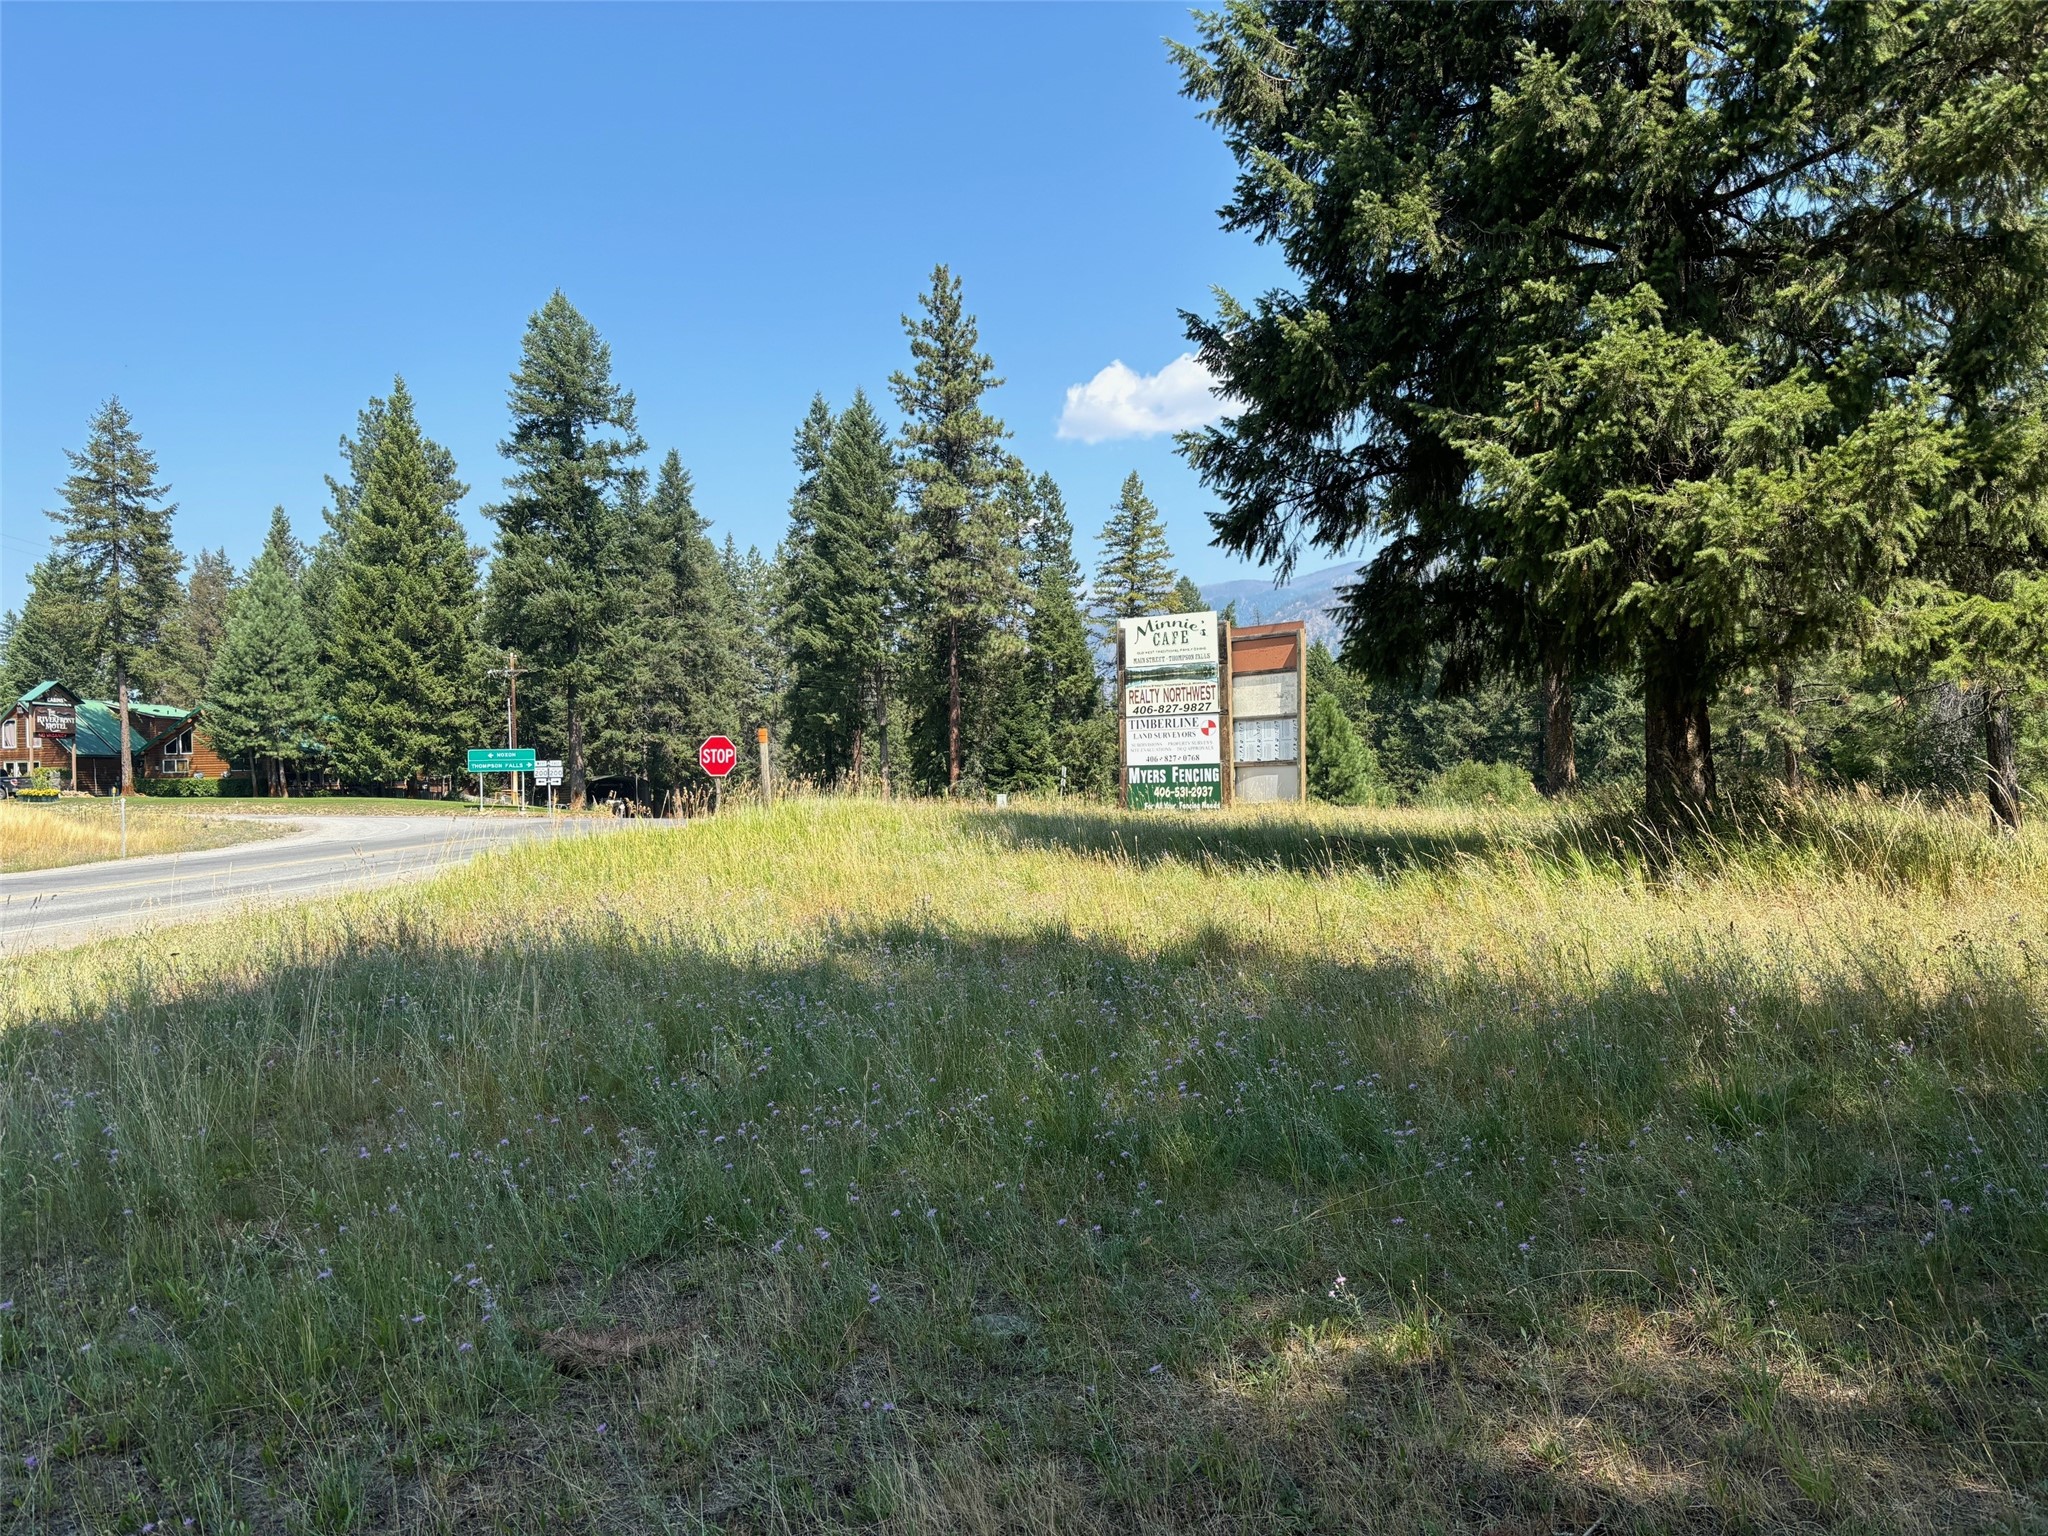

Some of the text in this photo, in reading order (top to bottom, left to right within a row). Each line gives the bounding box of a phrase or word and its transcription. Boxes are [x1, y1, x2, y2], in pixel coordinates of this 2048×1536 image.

[1134, 618, 1206, 644] Minnie's
[1153, 630, 1188, 646] CAFE
[1129, 685, 1216, 704] REALTY NORTHWEST
[1133, 702, 1212, 714] 406-827-9827
[1129, 717, 1199, 729] TIMBERLINE
[703, 749, 733, 763] STOP
[1129, 766, 1219, 784] MYERS FENCING
[1154, 786, 1213, 797] 406-531-2937
